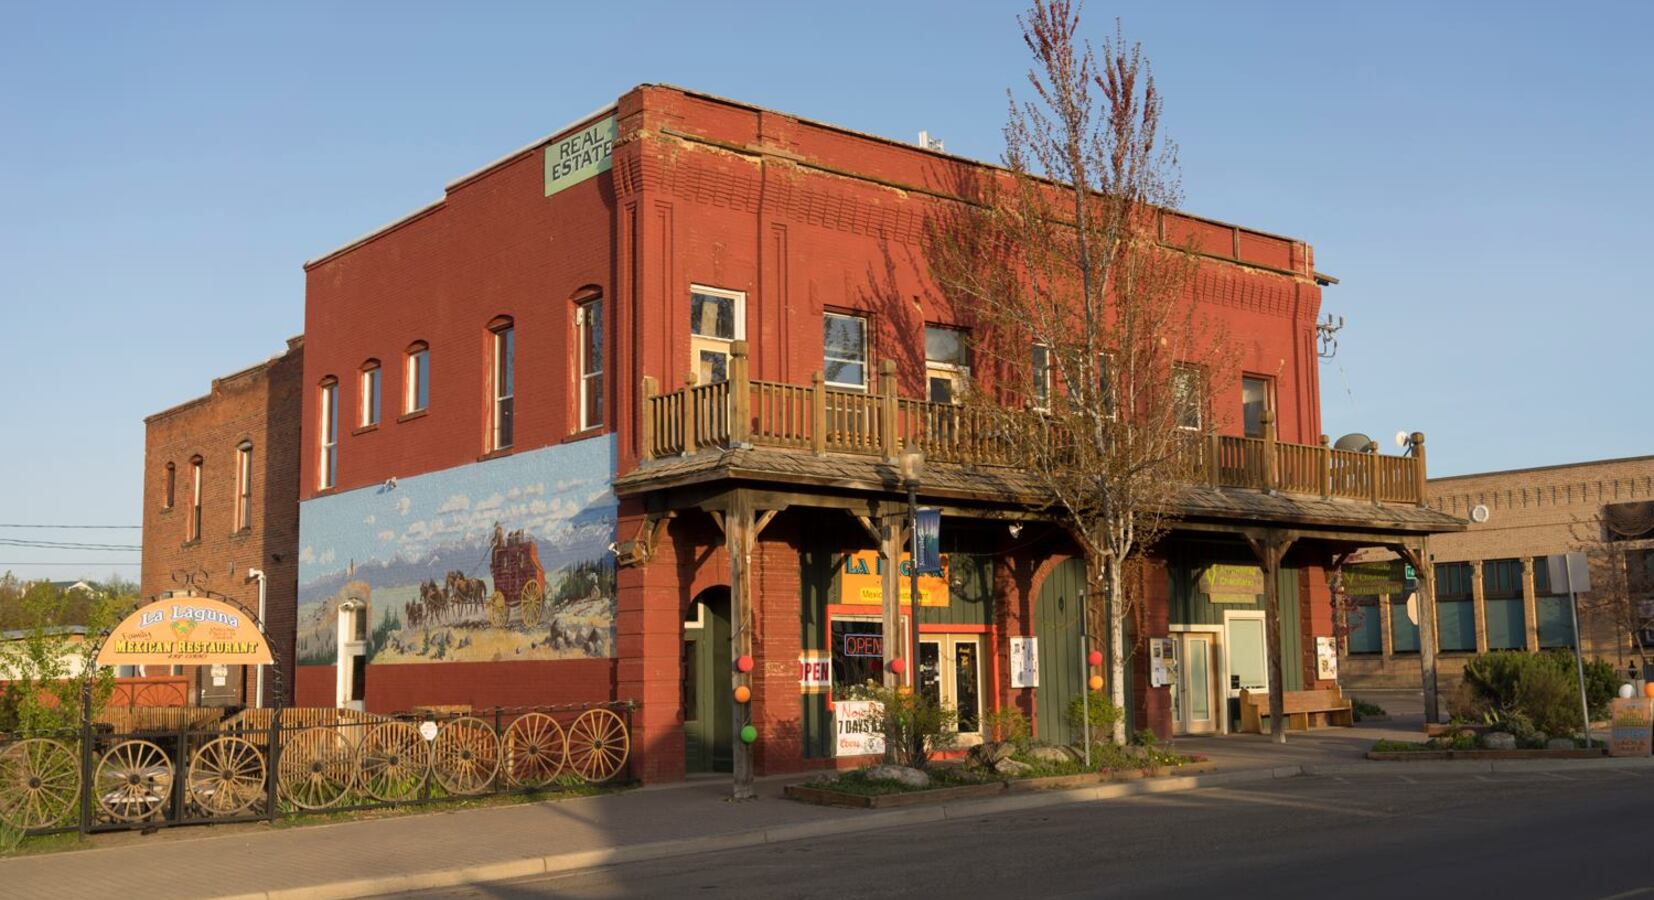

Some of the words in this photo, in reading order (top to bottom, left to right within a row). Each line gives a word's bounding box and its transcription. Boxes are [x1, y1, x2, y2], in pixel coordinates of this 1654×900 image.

[560, 128, 604, 160] REAL
[552, 140, 612, 180] ESTATE
[846, 556, 870, 575] LA
[140, 609, 163, 627] La
[171, 605, 239, 628] Laguna
[115, 640, 173, 654] MEXICAN
[178, 640, 258, 654] RESTAURANT
[847, 637, 883, 656] OPEN
[838, 720, 843, 734] 7
[845, 719, 869, 734] DAYS
